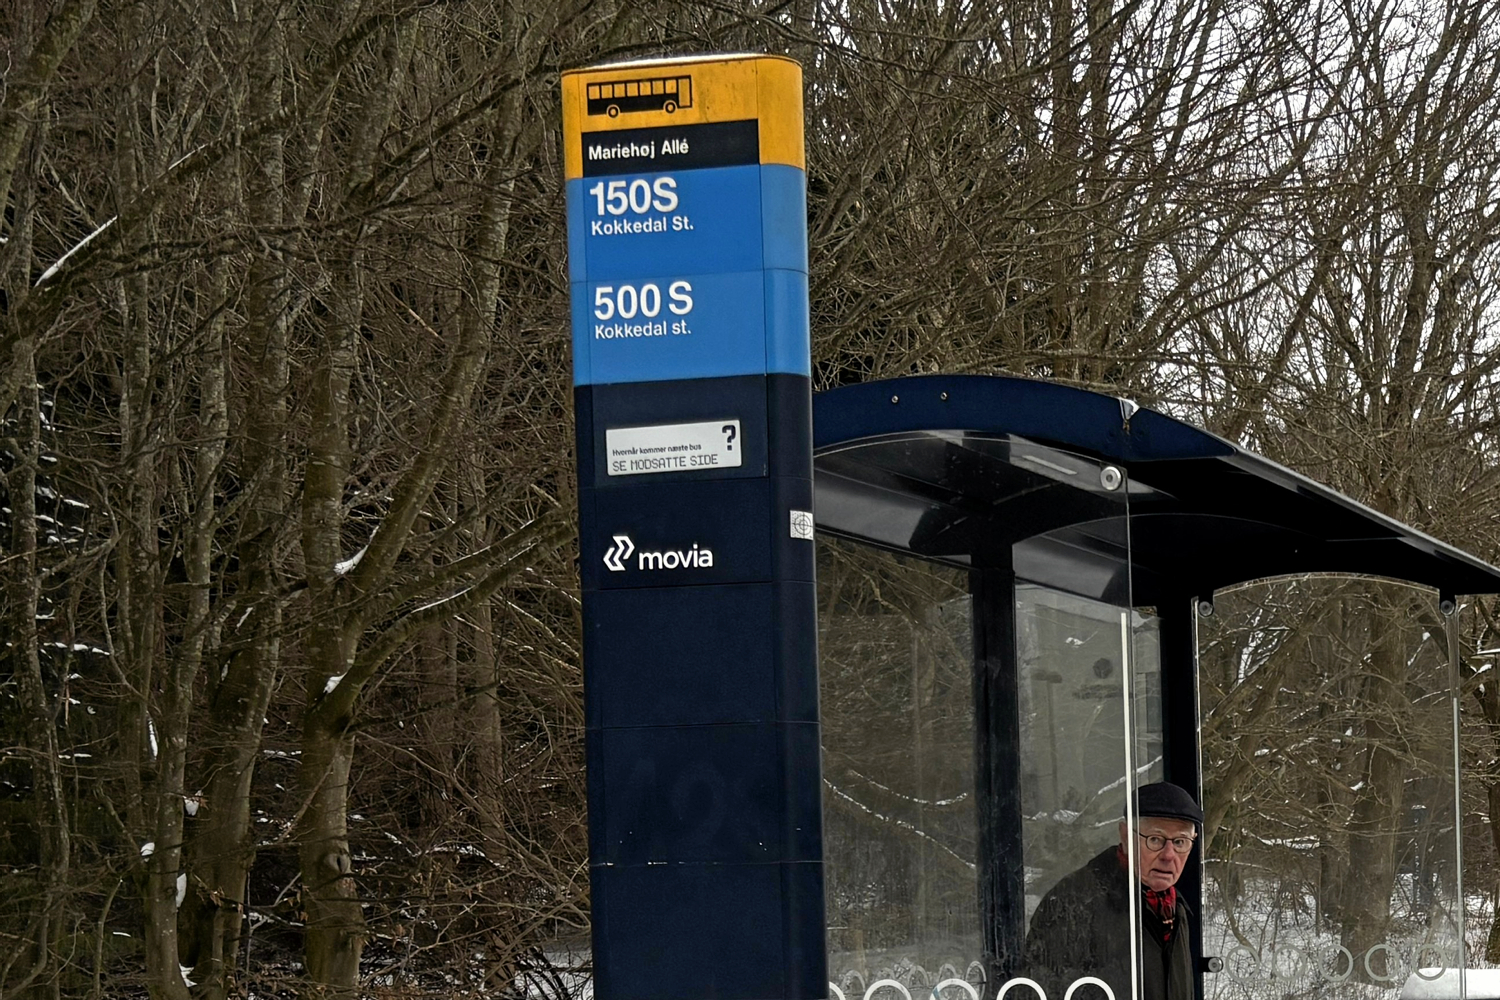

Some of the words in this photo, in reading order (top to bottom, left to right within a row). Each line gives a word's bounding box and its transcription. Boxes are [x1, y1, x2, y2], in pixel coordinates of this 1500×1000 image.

[588, 140, 656, 160] Mariehøj
[661, 137, 689, 155] Allé
[589, 177, 679, 216] 150S
[591, 217, 667, 236] Kokkedal
[672, 216, 694, 232] St.
[594, 283, 661, 321] 500
[668, 281, 693, 316] S
[594, 321, 667, 339] Kokkedal
[671, 319, 692, 335] st.
[612, 446, 638, 456] Hvornår
[640, 446, 666, 454] kommer
[689, 443, 702, 451] bus
[612, 460, 627, 472] SE
[630, 456, 687, 471] MODSATTE
[690, 453, 719, 466] SIDE
[638, 543, 714, 571] movia
